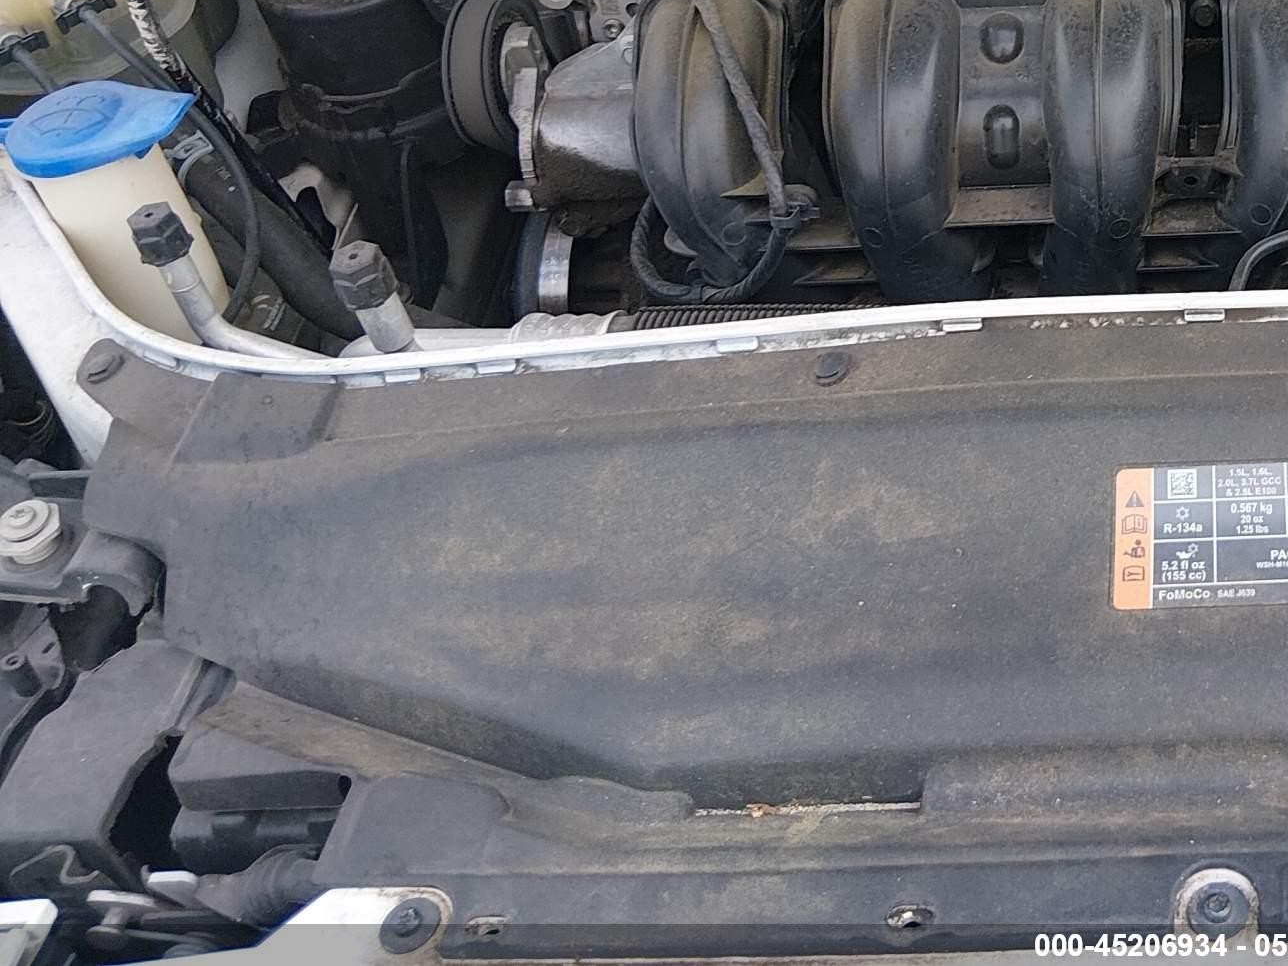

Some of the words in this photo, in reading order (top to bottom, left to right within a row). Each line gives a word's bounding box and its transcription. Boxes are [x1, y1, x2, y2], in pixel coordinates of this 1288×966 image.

[1230, 503, 1257, 514] 0.567
[1260, 502, 1273, 515] kg
[1240, 514, 1251, 524] 20
[1163, 522, 1203, 534] R-134a
[1235, 524, 1254, 534] 1.25
[1255, 524, 1269, 533] lbs
[1161, 560, 1178, 571] 5.2
[1180, 559, 1189, 570] fl
[1191, 561, 1206, 569] oz
[1161, 570, 1187, 583] (155
[1188, 570, 1207, 582] cc)
[1158, 588, 1211, 601] FoMoCo
[1217, 588, 1235, 598] SAE
